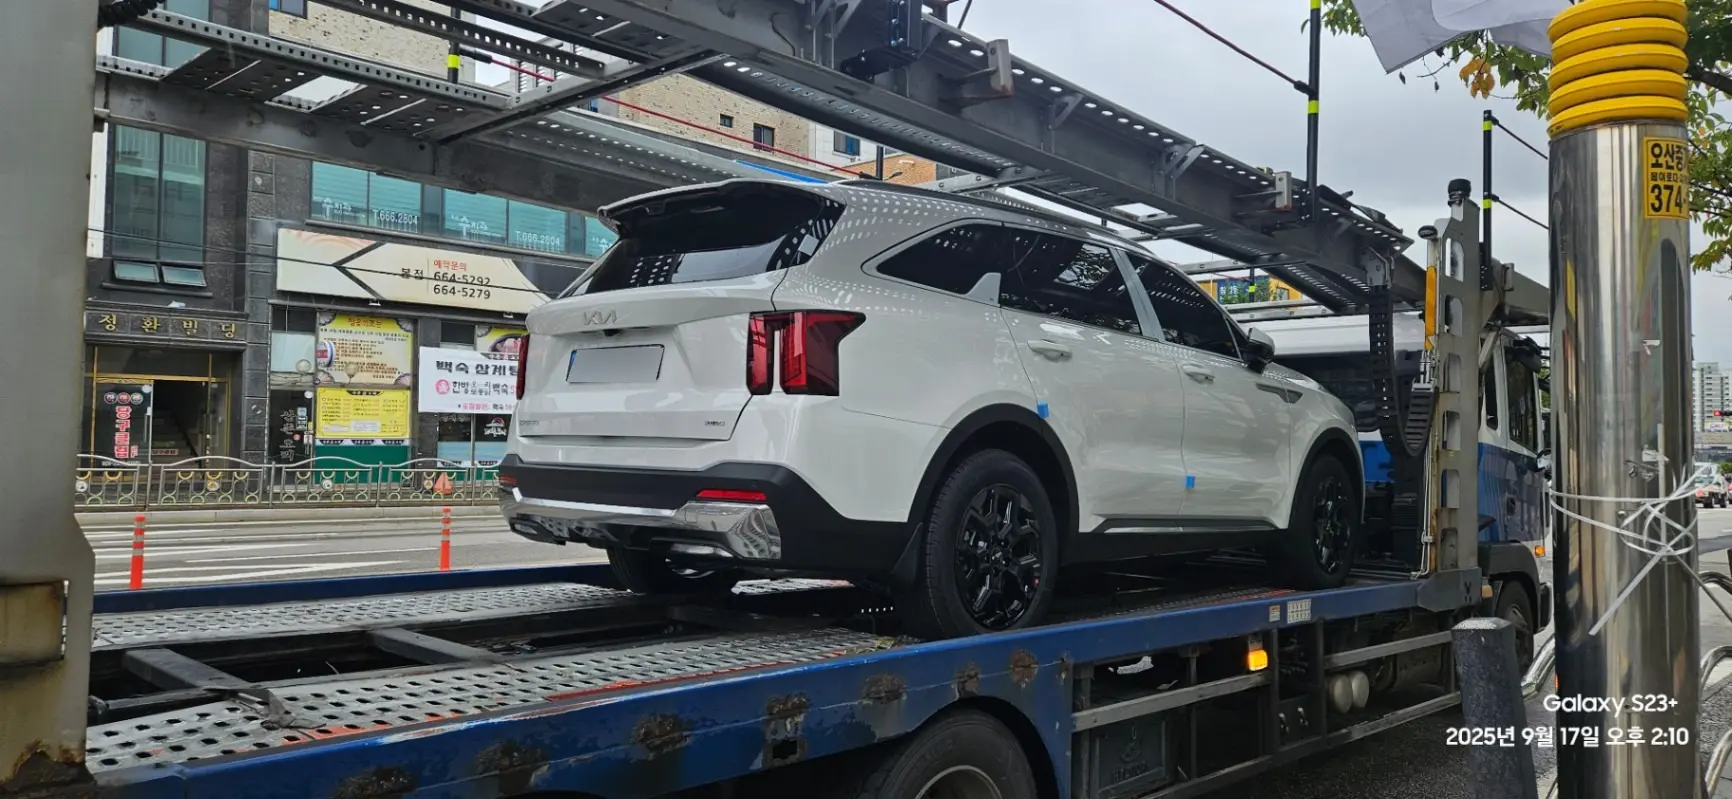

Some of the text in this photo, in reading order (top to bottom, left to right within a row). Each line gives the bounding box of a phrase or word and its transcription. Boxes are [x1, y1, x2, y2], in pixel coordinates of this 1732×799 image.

[373, 209, 418, 225] T.666.2804
[515, 230, 560, 246] T.666.2804
[433, 259, 467, 271] 예약문의
[433, 271, 491, 286] 664-5292
[433, 284, 491, 300] 664-5279
[435, 360, 469, 374] 백숙
[452, 381, 469, 395] 한방
